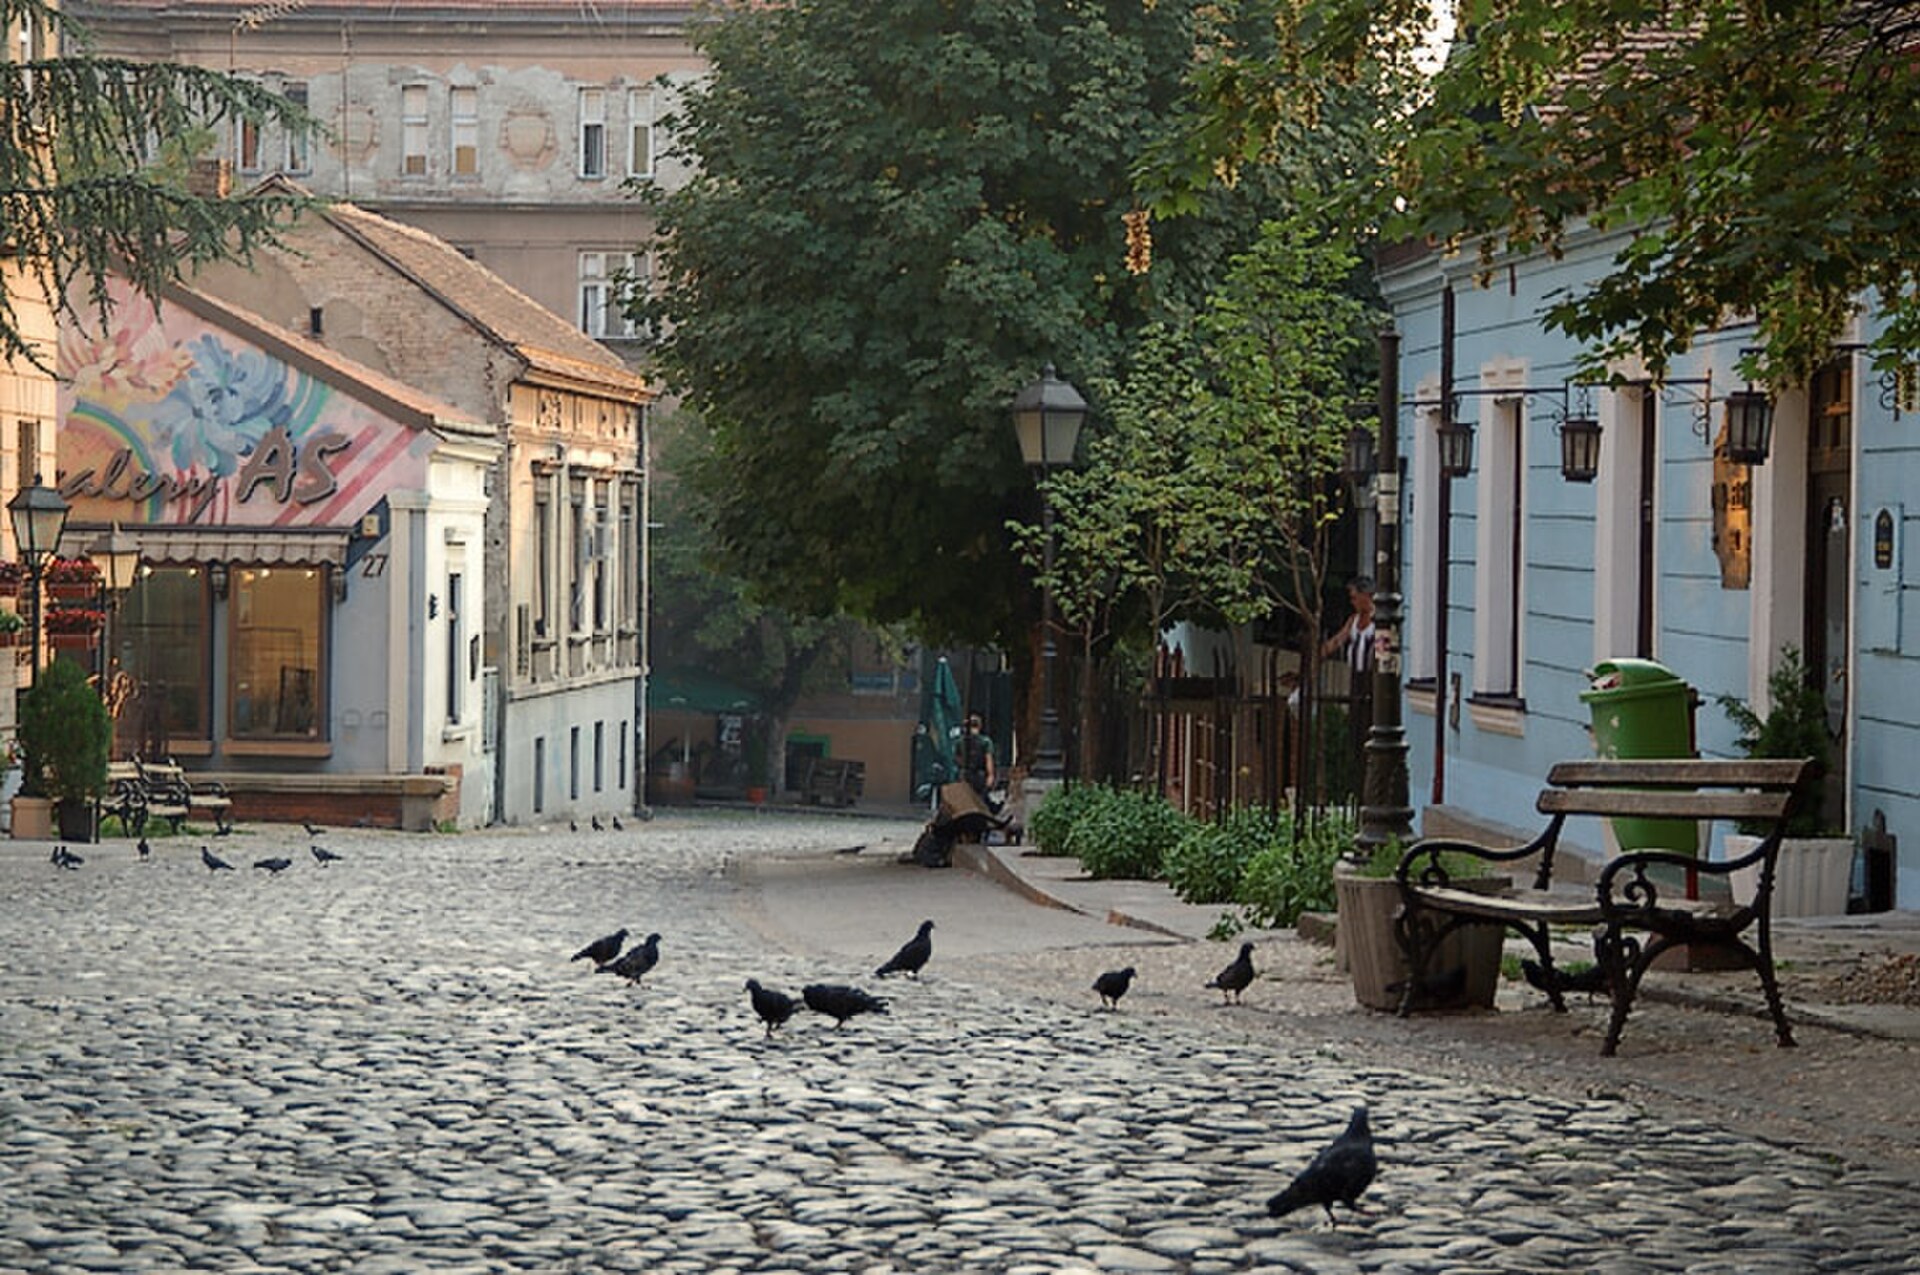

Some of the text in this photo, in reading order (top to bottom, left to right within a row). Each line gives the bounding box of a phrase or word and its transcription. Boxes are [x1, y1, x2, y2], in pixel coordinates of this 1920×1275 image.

[56, 425, 352, 523] alery AS
[362, 554, 388, 578] 27
